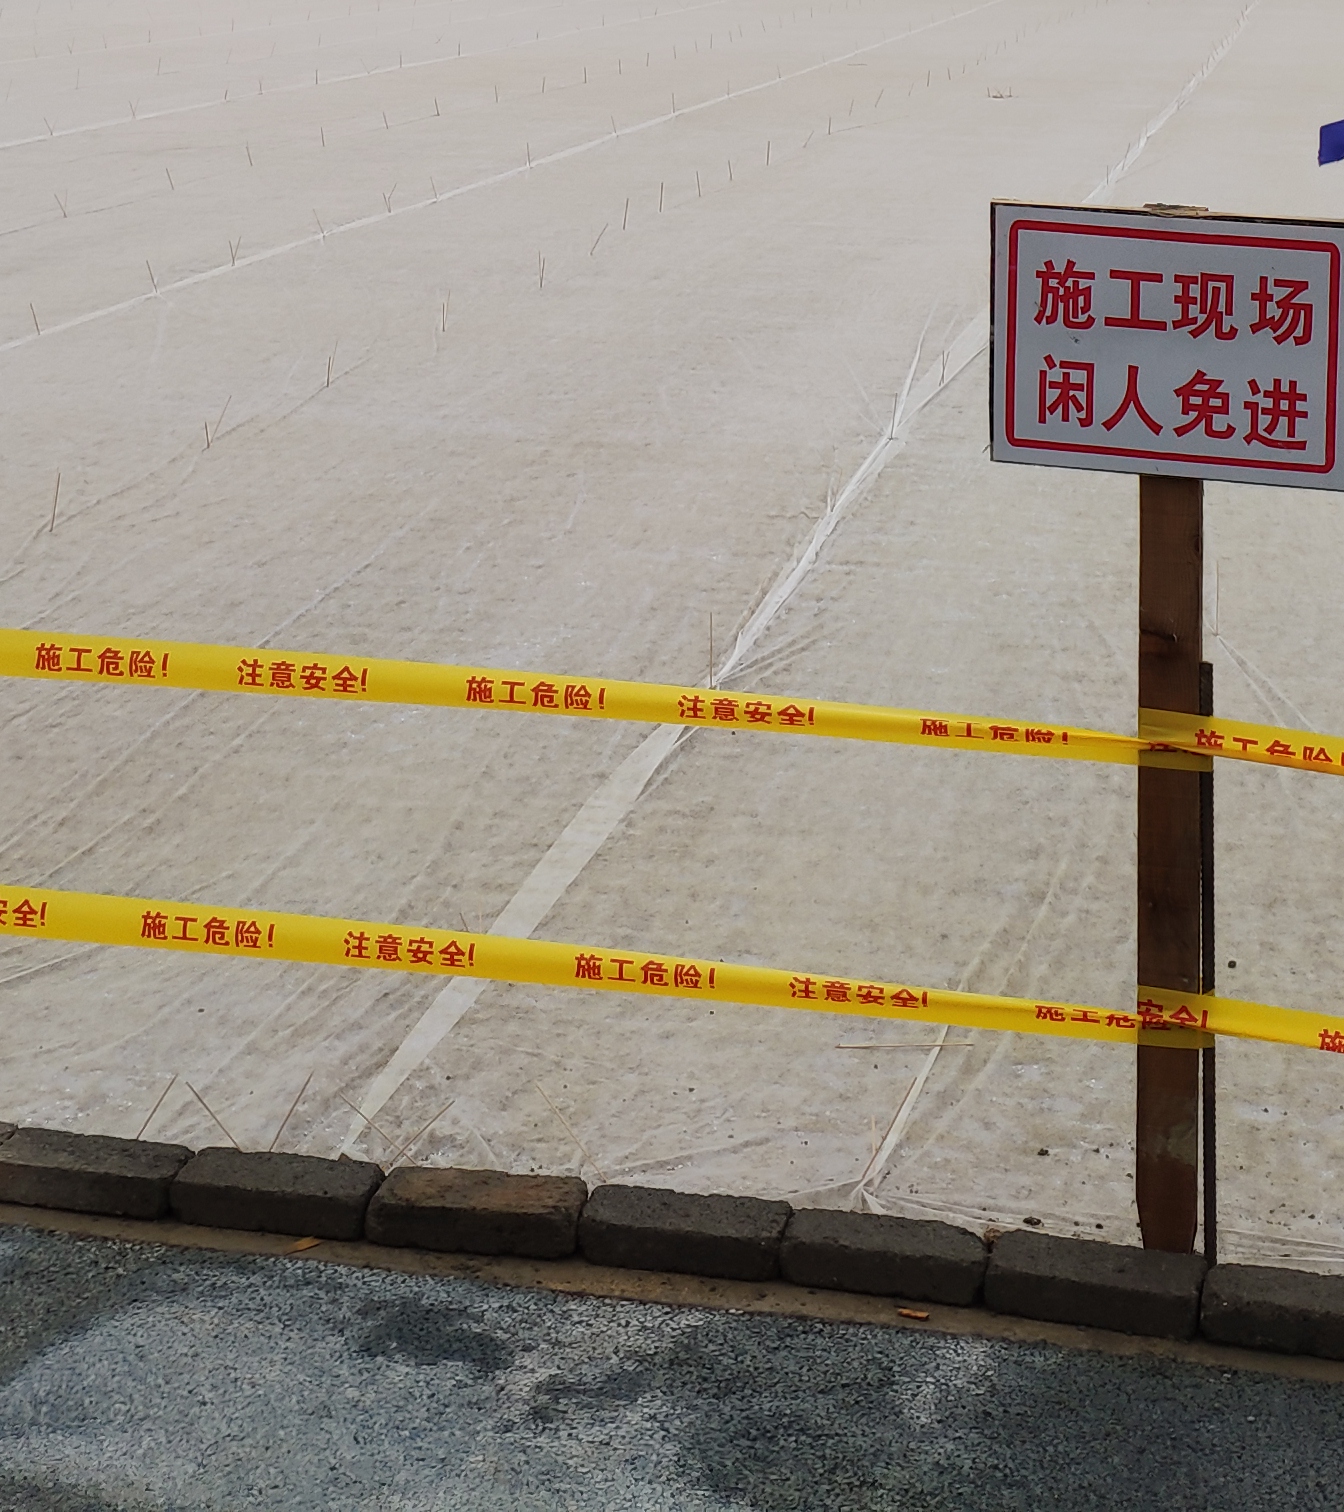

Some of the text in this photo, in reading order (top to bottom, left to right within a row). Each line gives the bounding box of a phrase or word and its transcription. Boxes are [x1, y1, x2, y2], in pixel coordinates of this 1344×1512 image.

[1033, 258, 1314, 347] 施工现场
[1036, 353, 1310, 452] 闲人免进
[33, 641, 170, 681] 施工危险!
[235, 657, 369, 696] 注意安全!
[463, 674, 607, 713] 施工危险!
[676, 693, 817, 729] 注意安全!
[139, 909, 276, 951] 施工危险!
[341, 929, 476, 970] 注意安全!
[572, 951, 718, 991] 施工危险!
[787, 975, 929, 1010] 注意安全!
